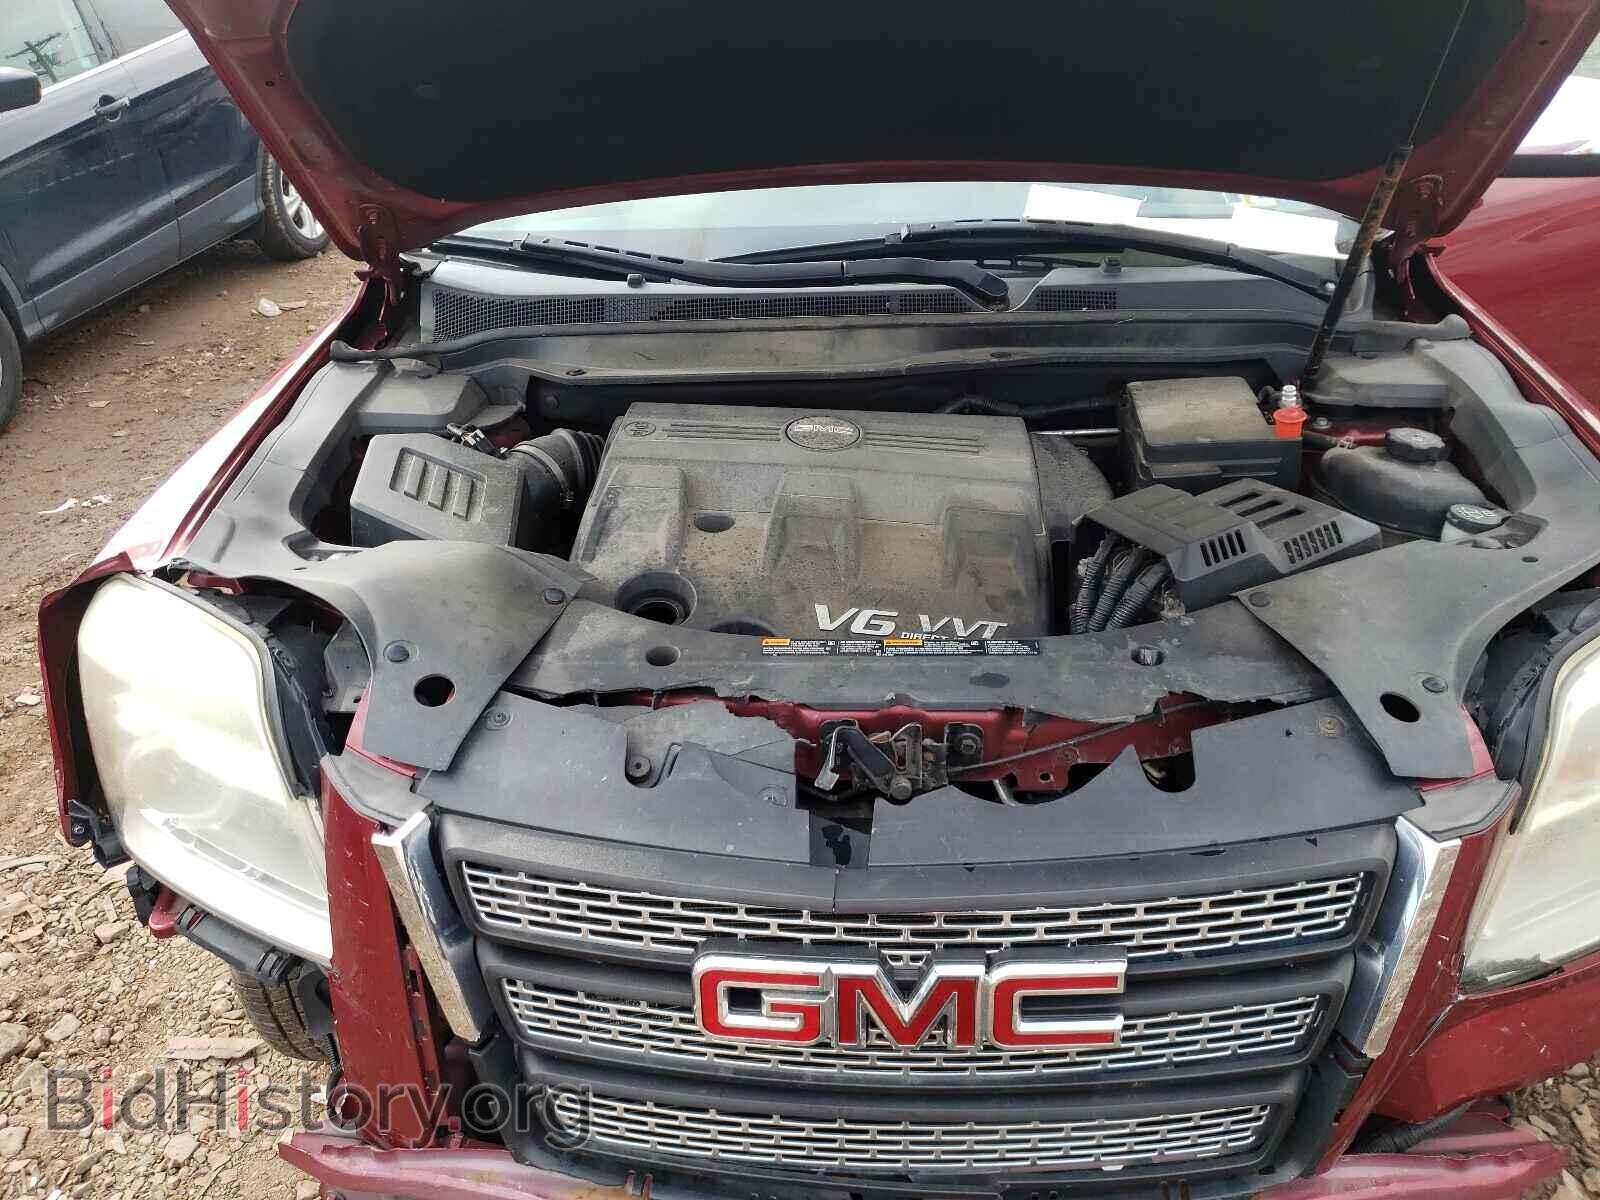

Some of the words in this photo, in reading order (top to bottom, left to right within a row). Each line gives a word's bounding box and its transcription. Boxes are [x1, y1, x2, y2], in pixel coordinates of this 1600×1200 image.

[814, 603, 899, 636] V6
[919, 614, 1009, 639] VVT
[692, 954, 1127, 1050] GMC
